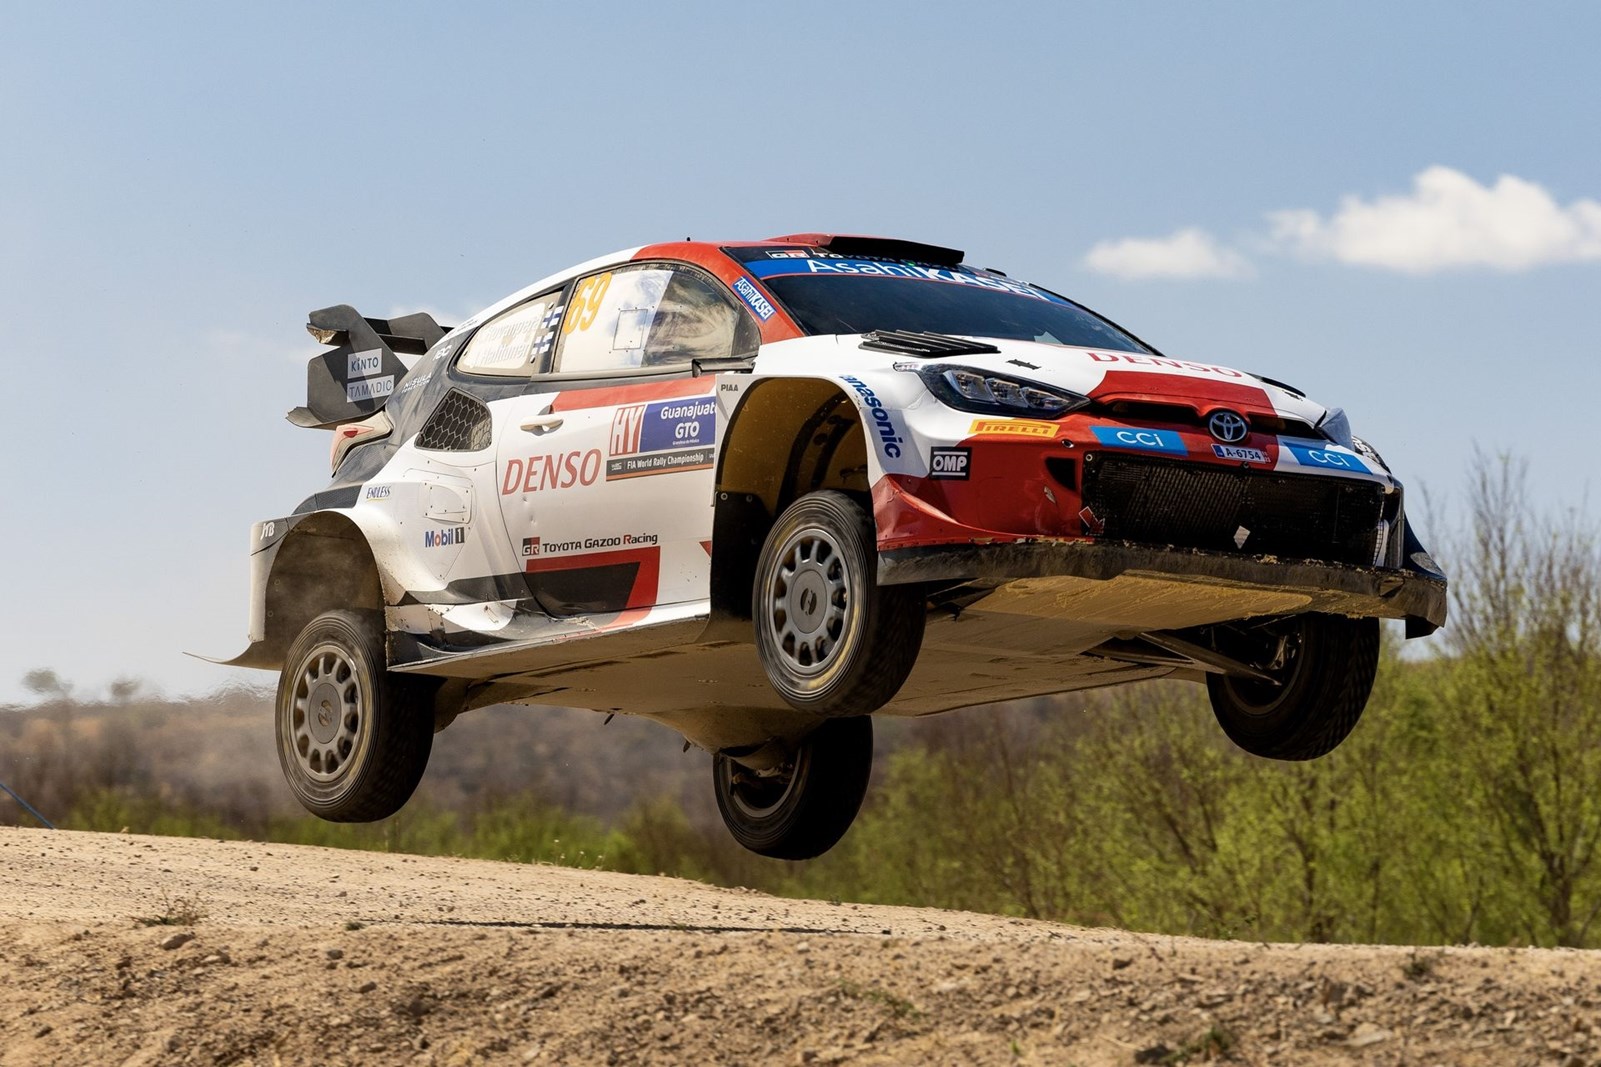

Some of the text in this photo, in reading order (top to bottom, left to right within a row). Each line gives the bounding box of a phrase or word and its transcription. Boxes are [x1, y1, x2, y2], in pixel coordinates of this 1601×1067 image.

[807, 259, 1050, 302] AsahiKASEI
[563, 272, 612, 335] 69
[735, 277, 776, 319] AsahiKASEI
[1087, 352, 1242, 378] DENSO
[350, 380, 393, 397] TAMADIC
[840, 374, 903, 459] anasonic
[675, 421, 700, 439] GTO
[975, 420, 1053, 435] PIRELLI
[627, 461, 637, 470] FIA
[637, 458, 652, 469] World
[653, 457, 666, 468] Rally
[667, 453, 704, 465] Championship
[932, 455, 967, 471] OMP
[1225, 448, 1261, 460] A-6754
[502, 449, 602, 496] DENSO
[366, 485, 391, 499] ENDLESS
[425, 527, 465, 548] Mobil 1
[543, 541, 582, 553] TOYOTA
[584, 537, 621, 549] GAZOO
[623, 533, 658, 545] Racing
